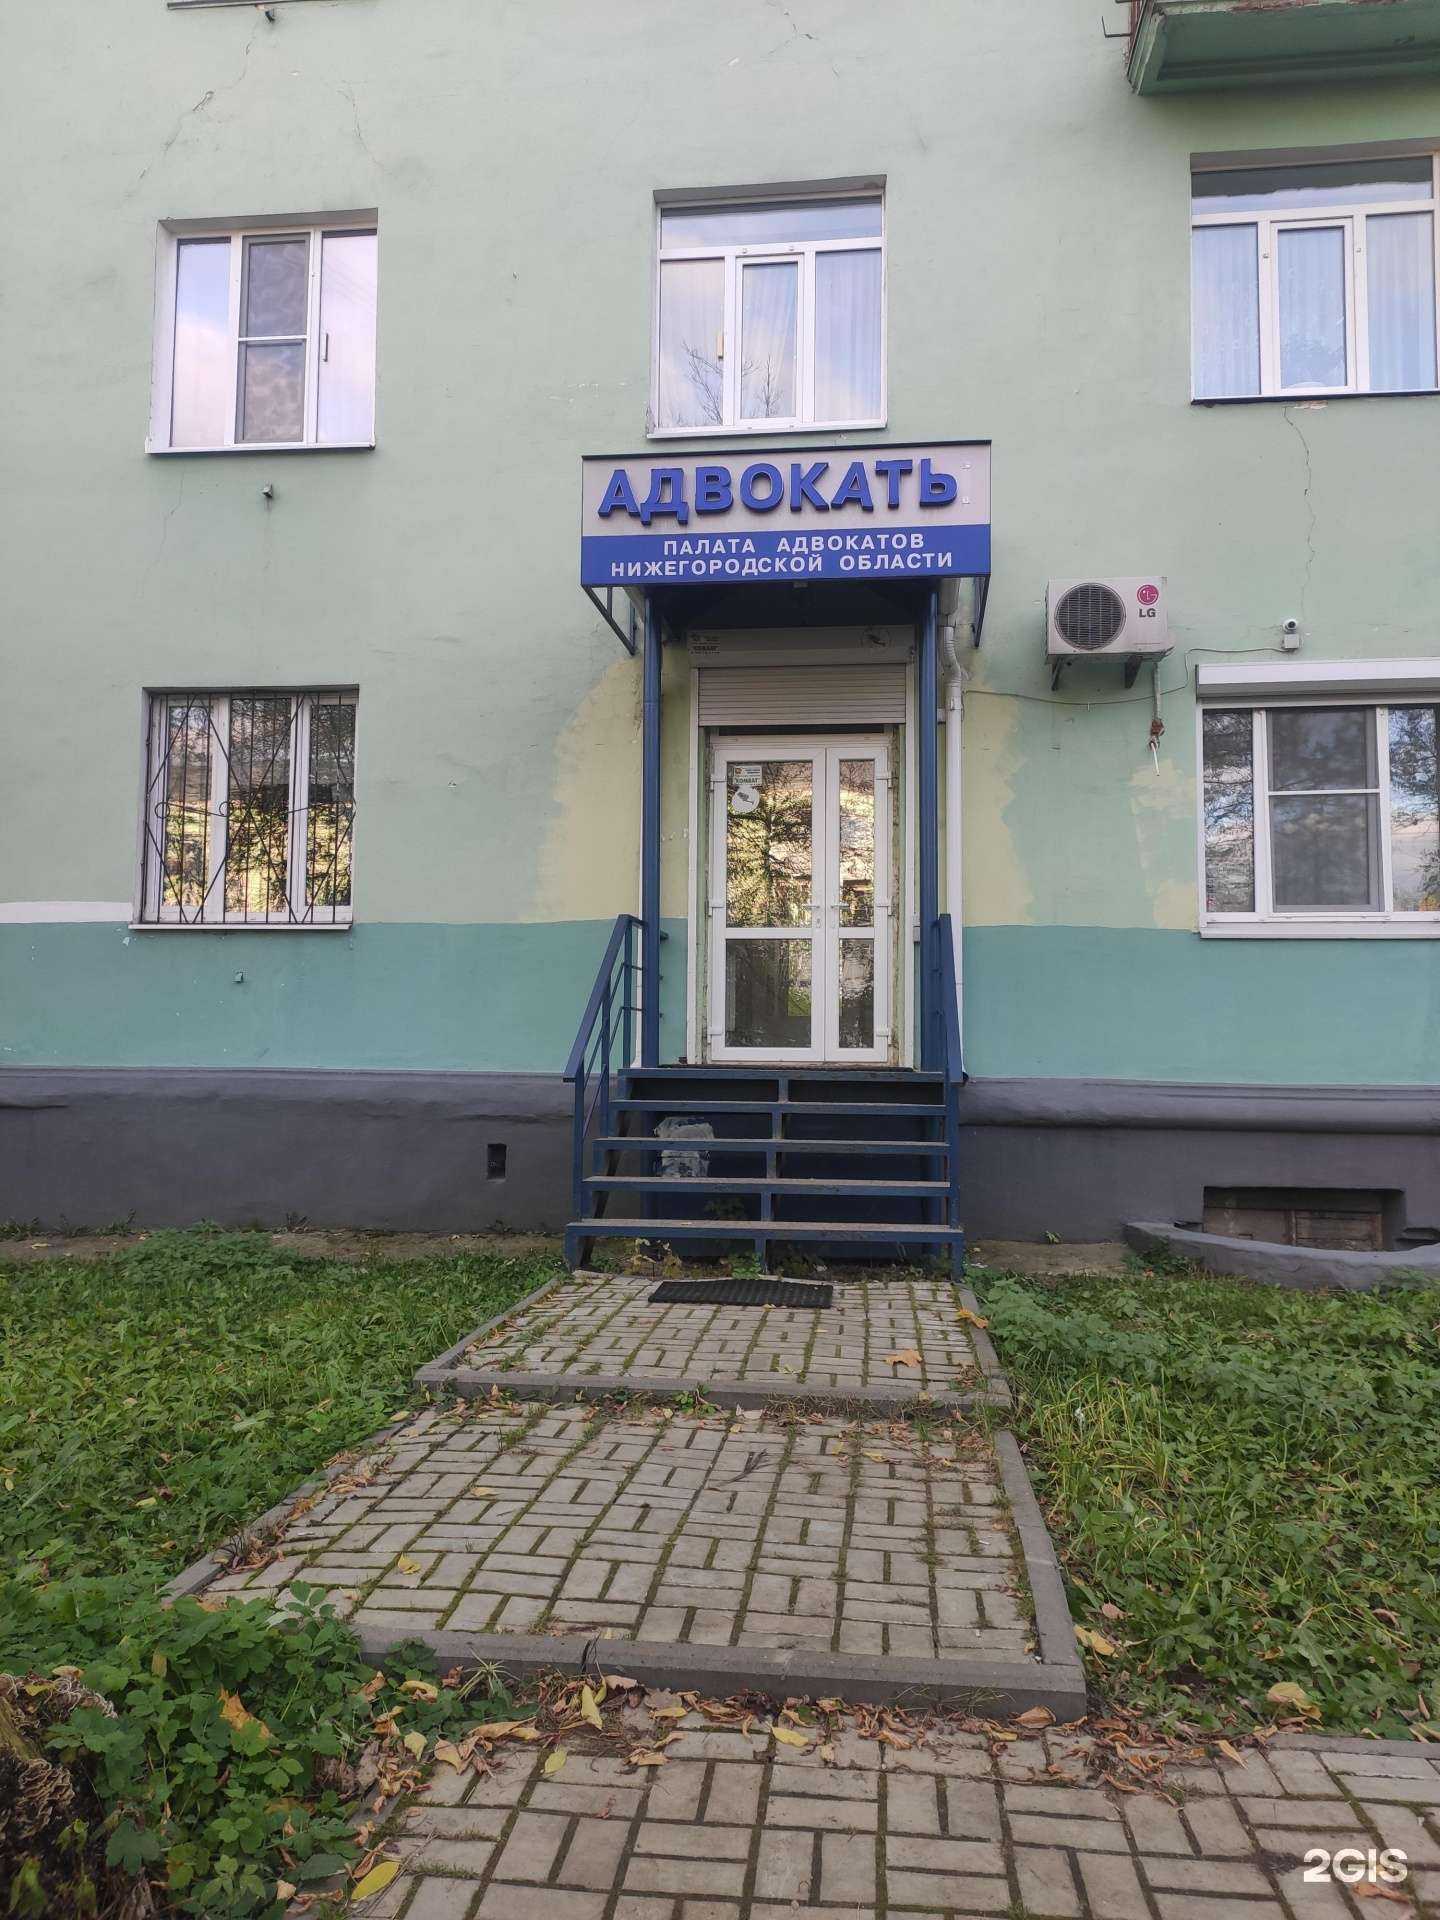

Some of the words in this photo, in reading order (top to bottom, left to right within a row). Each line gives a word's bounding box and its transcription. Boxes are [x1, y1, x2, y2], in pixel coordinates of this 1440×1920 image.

[597, 458, 958, 525] АДВОКАТЬ
[664, 538, 756, 556] ПАЛАТА
[777, 533, 925, 555] АДВОКАТОВ
[611, 554, 823, 577] НИЖЕГОРОДСКОЙ
[839, 552, 952, 571] ОБЛАСТИ
[1138, 608, 1157, 618] LG
